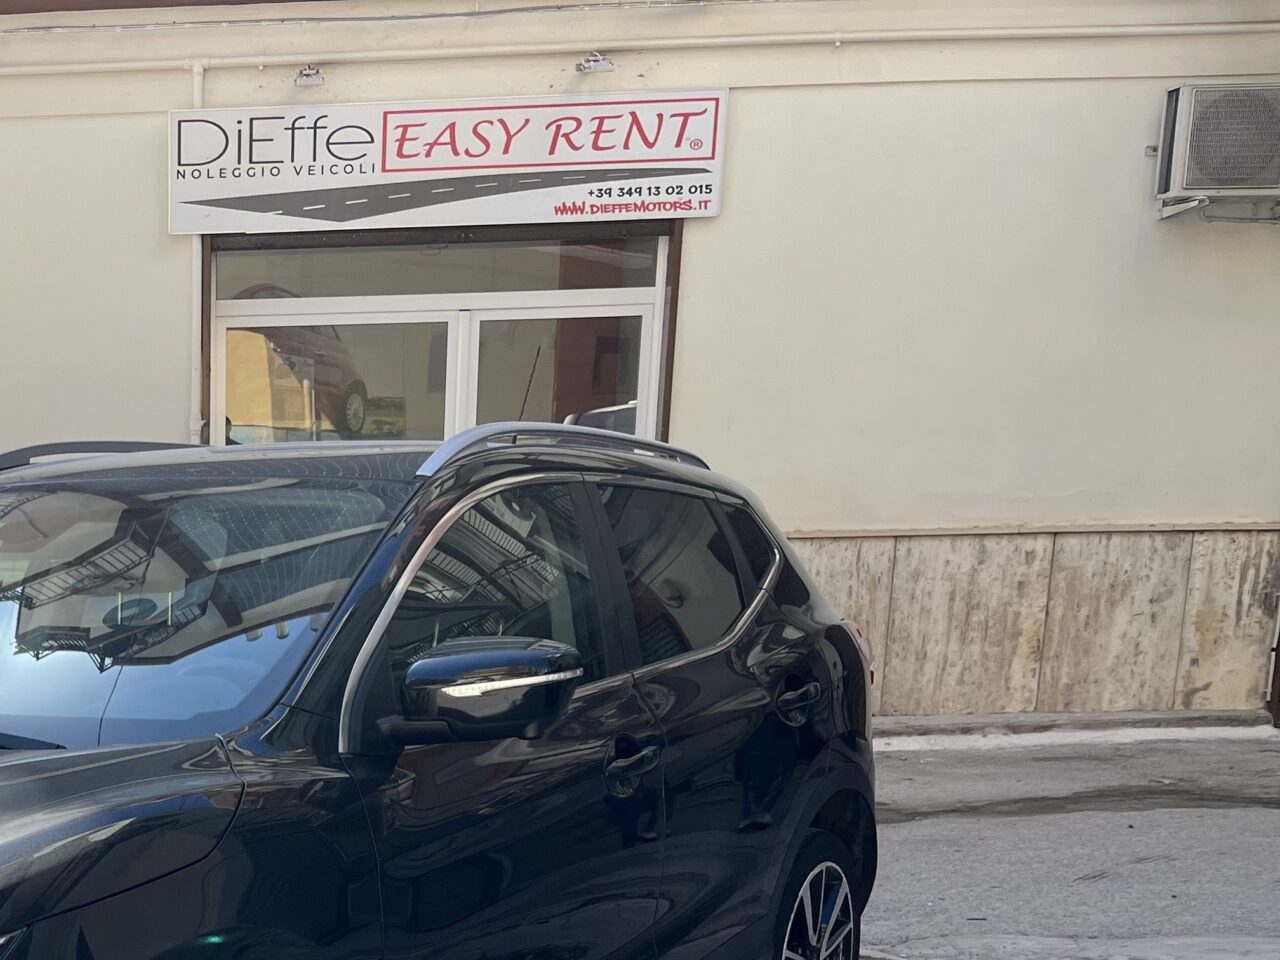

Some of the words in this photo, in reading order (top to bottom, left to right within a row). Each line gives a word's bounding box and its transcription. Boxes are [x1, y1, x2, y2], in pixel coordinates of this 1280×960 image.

[177, 115, 375, 167] DiEffe
[393, 117, 531, 159] EASY
[544, 108, 708, 156] RENT
[176, 166, 281, 180] NOLEGGIO
[293, 163, 376, 176] VEICOLI
[587, 187, 613, 198] +39
[617, 185, 643, 198] 349
[647, 185, 661, 196] 13
[665, 185, 684, 196] 02
[688, 184, 713, 195] 015
[554, 199, 713, 216] WWW.DIEFFEMOTORS.IT
